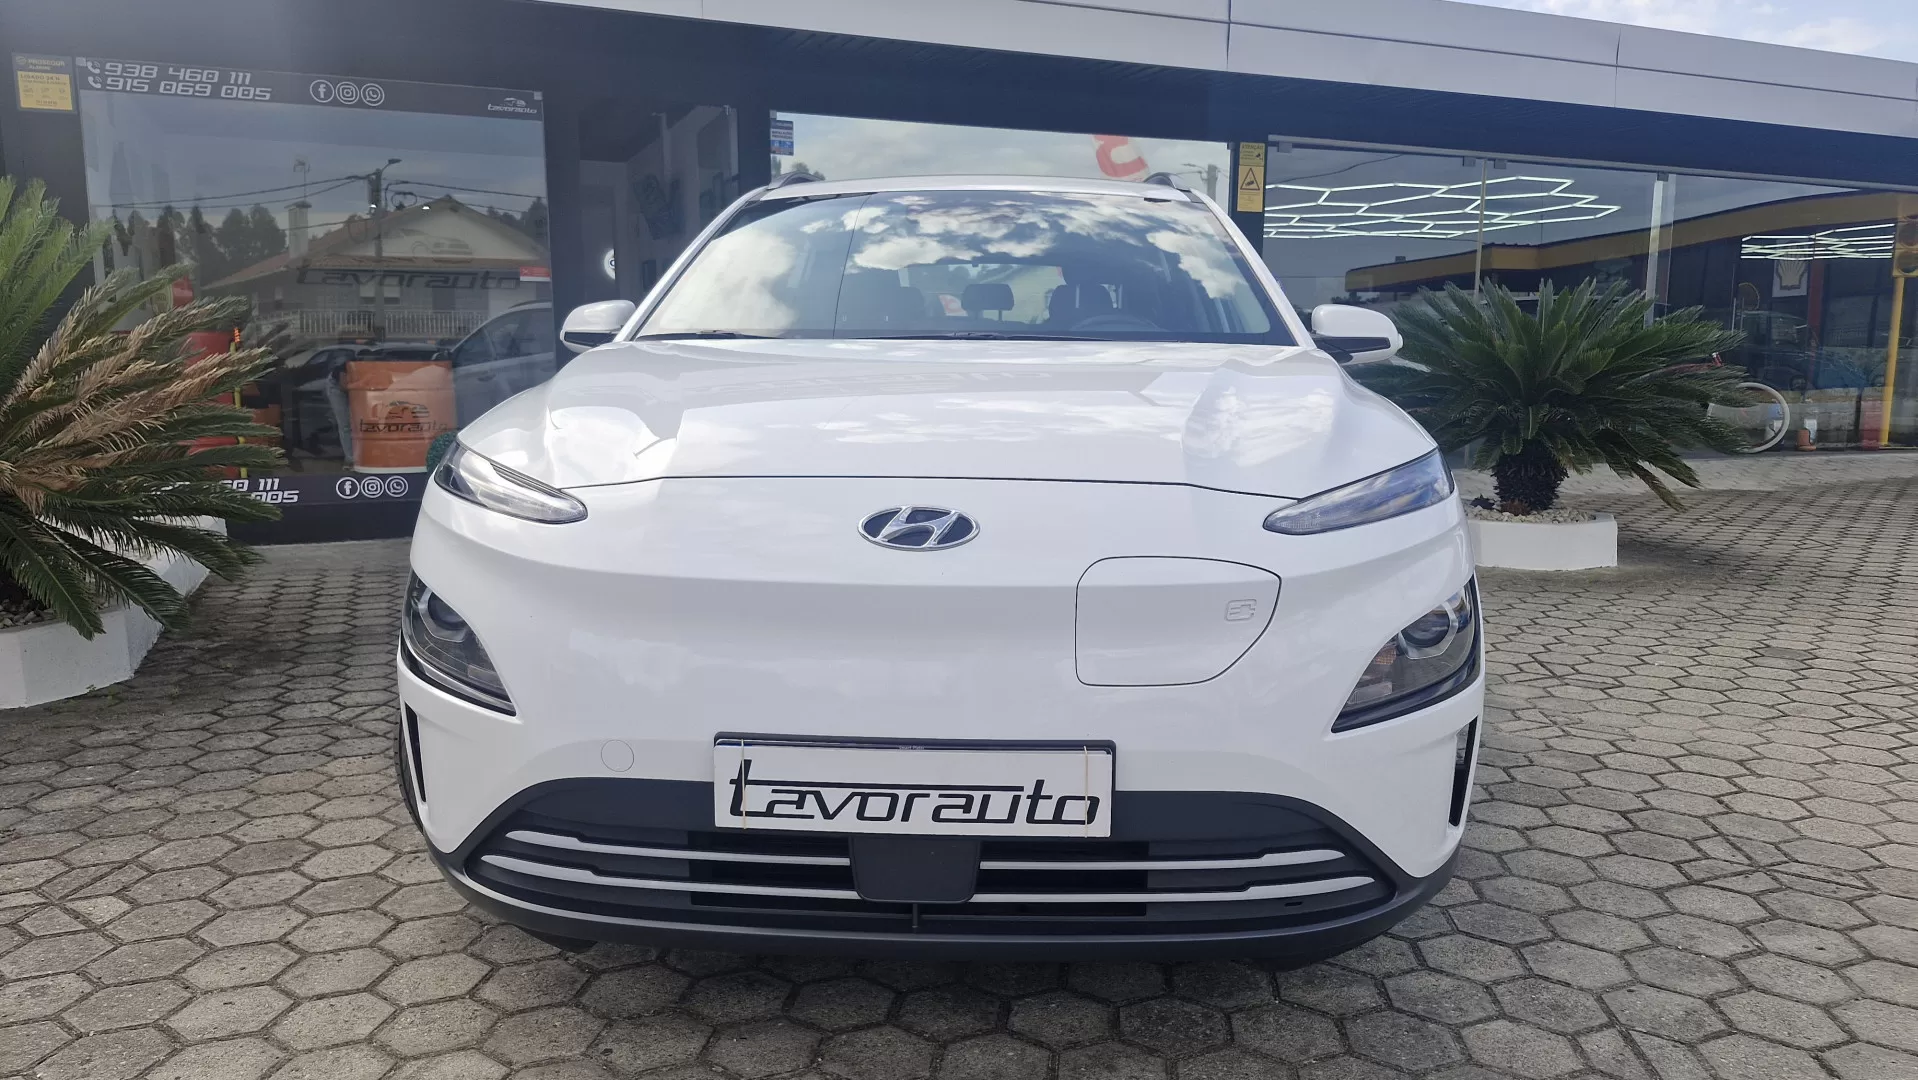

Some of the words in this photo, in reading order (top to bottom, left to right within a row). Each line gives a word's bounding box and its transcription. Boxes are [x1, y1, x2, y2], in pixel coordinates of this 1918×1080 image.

[105, 62, 158, 78] 938
[168, 67, 220, 83] 460
[229, 71, 252, 85] 111
[106, 77, 150, 93] 915
[159, 81, 212, 97] 069
[220, 85, 272, 100] 005
[258, 478, 279, 491] 111
[729, 758, 1101, 826] tavorauto
